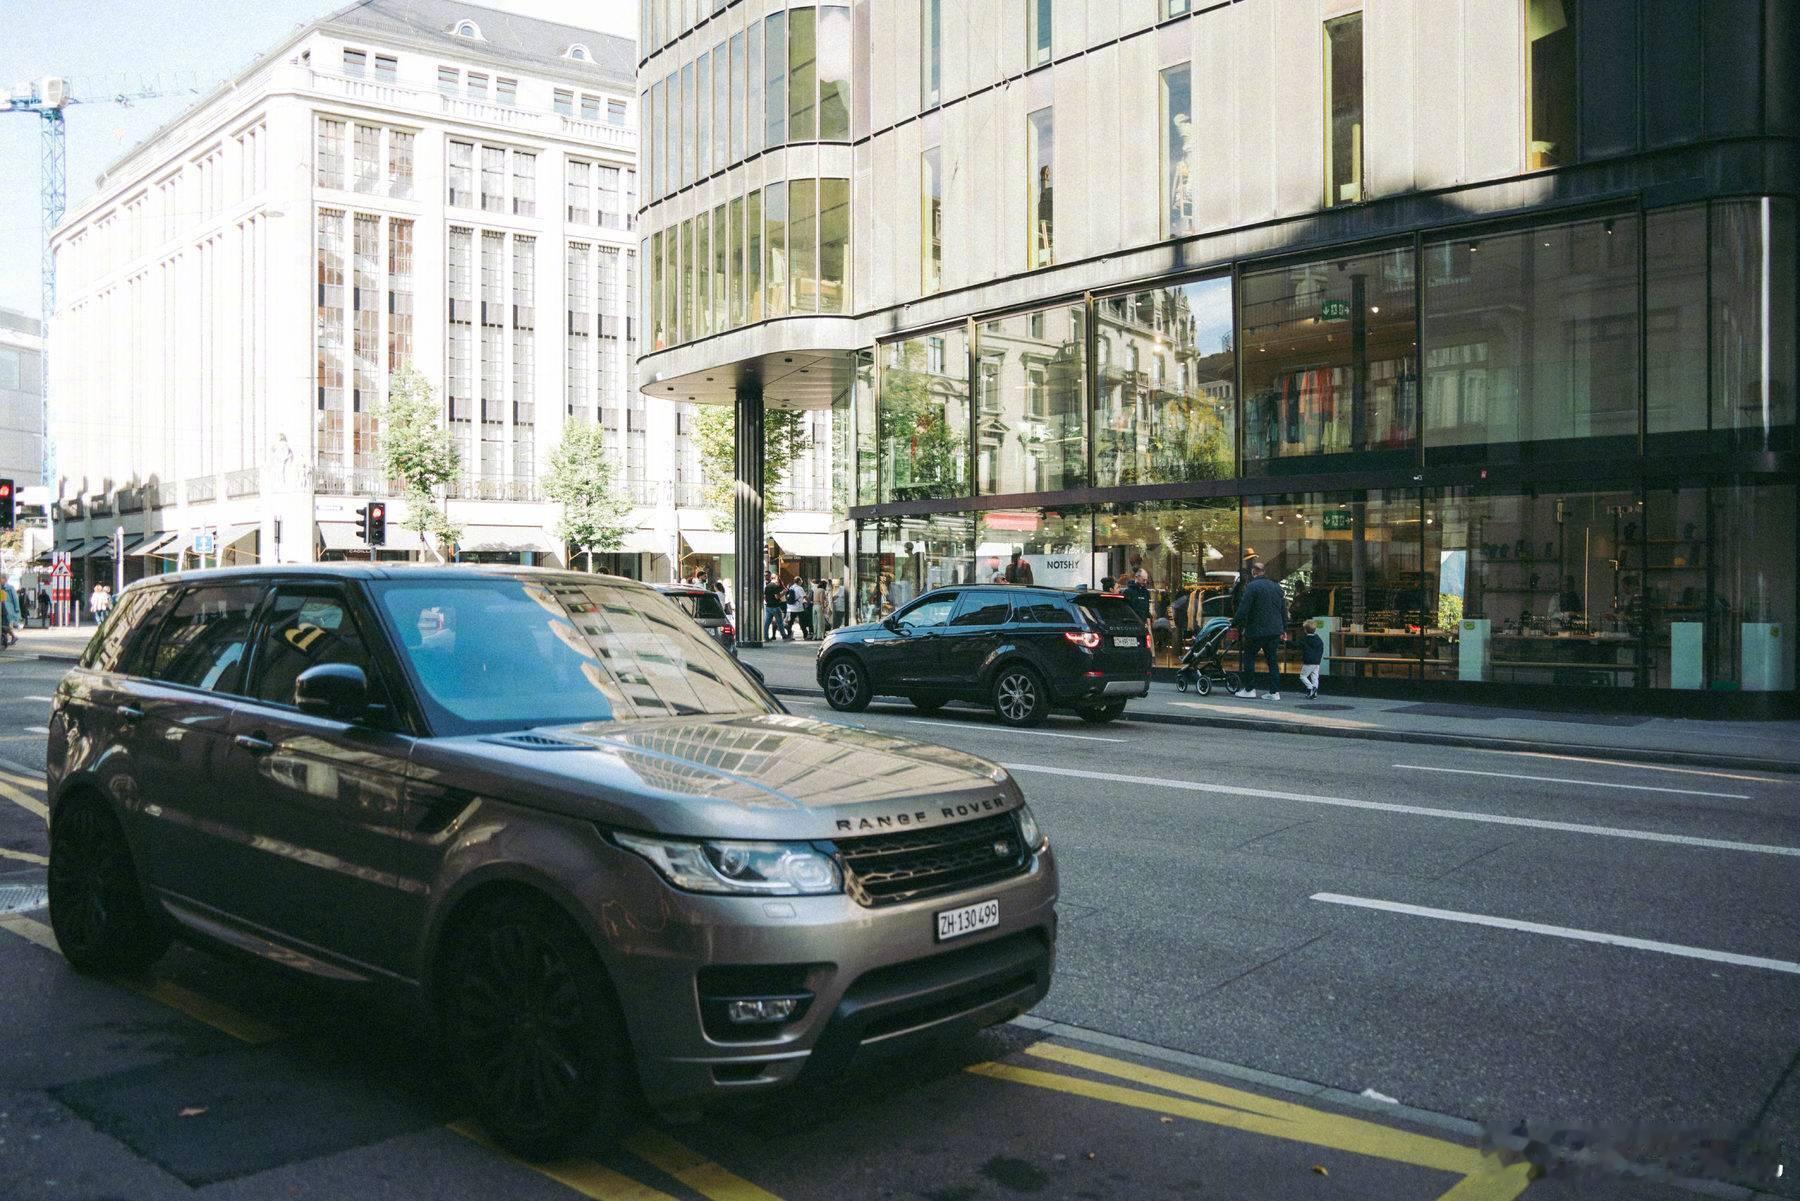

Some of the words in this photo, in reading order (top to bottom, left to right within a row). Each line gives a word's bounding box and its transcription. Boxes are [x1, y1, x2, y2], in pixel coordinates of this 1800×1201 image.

[1046, 560, 1080, 569] NOTSHY
[836, 811, 928, 831] RANGE
[941, 797, 1005, 818] ROVER
